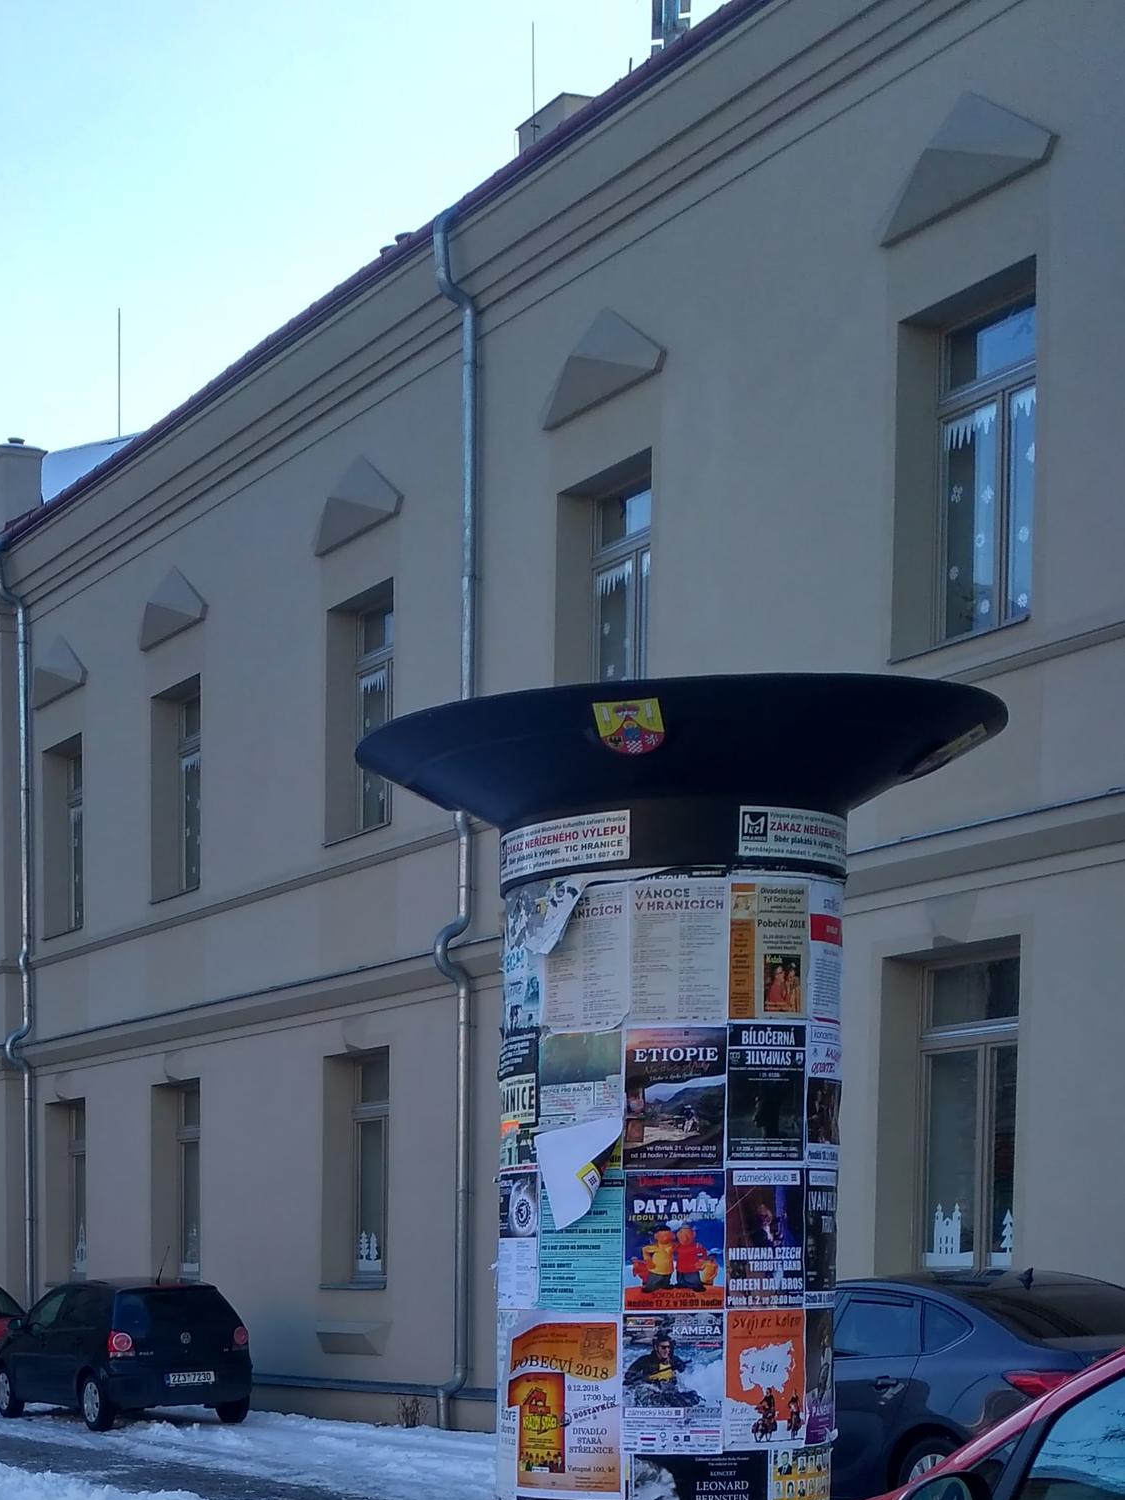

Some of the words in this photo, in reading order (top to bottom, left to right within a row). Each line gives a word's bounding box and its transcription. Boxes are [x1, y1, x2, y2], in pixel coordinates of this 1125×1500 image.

[582, 824, 626, 839] VÝLEPU
[564, 843, 579, 853] TIC
[581, 839, 623, 852] HRANICE
[635, 887, 690, 899] VÁNOCE
[635, 901, 644, 911] V
[647, 897, 724, 911] HRANICÍCH
[757, 919, 788, 928] Pobečví
[789, 920, 806, 929] 2018
[741, 1026, 795, 1046] BÍLOČERNÁ
[634, 1047, 719, 1062] ETIOPIE
[745, 1050, 792, 1065] SYMPATIE
[633, 1199, 668, 1214] PAT
[682, 1199, 719, 1213] MAT
[728, 1247, 773, 1260] NIRVANA
[775, 1247, 802, 1259] CZECH
[749, 1260, 782, 1271] TRIBUTE
[783, 1260, 802, 1271] BAND
[729, 1278, 761, 1291] GREEN
[781, 1277, 803, 1290] BROS
[727, 1295, 747, 1305] Pátek
[672, 1325, 721, 1335] KAMERA
[511, 1354, 573, 1374] POBEČVÍ
[575, 1364, 610, 1380] 2018
[577, 1436, 602, 1444] STARÁ
[569, 1446, 614, 1454] STŘELNICE
[696, 1480, 749, 1491] LEONARD
